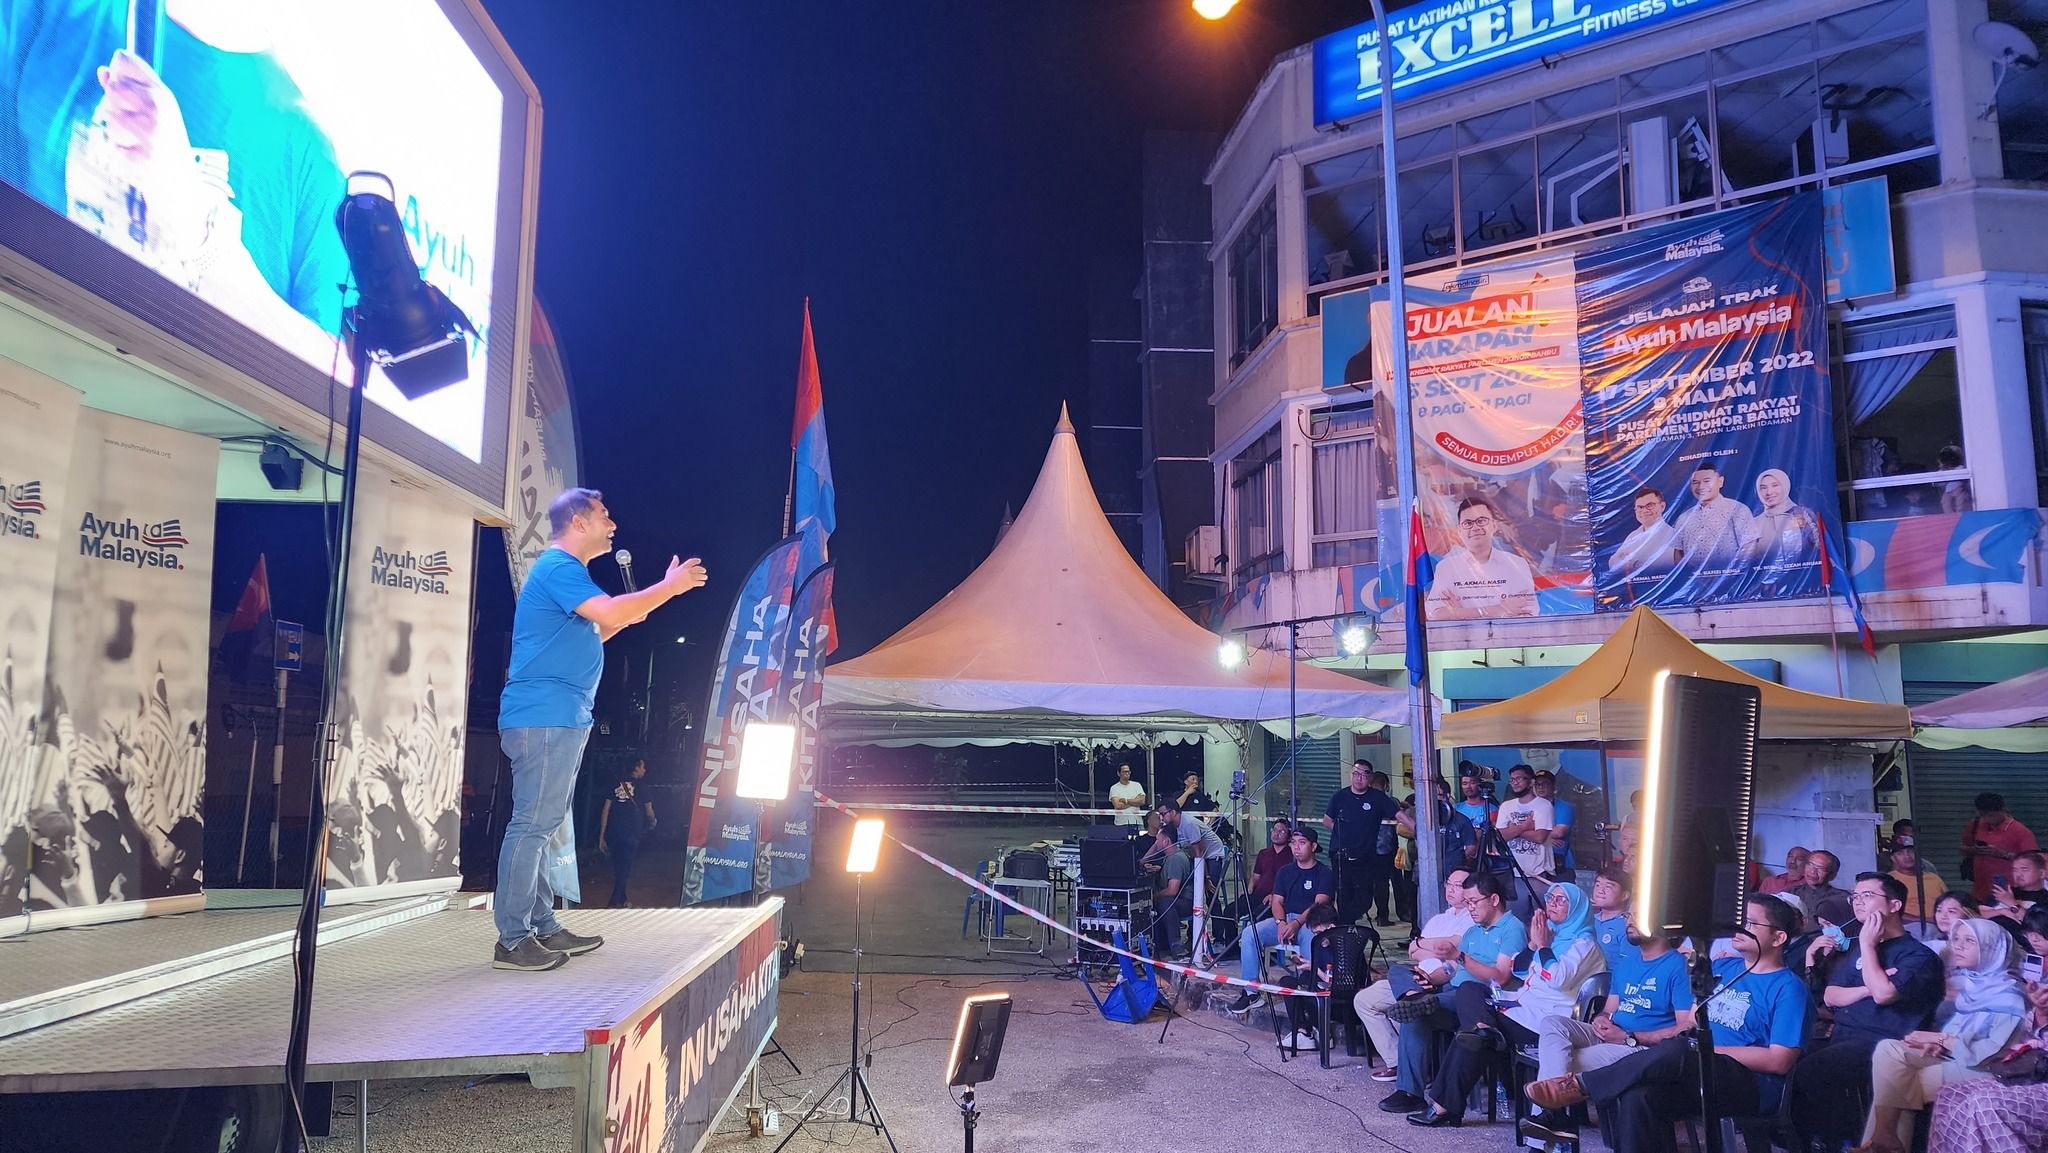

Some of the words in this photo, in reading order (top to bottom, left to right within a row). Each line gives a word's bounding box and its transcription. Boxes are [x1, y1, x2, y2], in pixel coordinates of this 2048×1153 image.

[1408, 0, 1475, 32] LATIHAN
[1582, 0, 1668, 37] FITNESS
[402, 195, 474, 287] Ayuh
[1665, 243, 1724, 261] Malaysia.
[1408, 295, 1528, 337] JUALAN
[1621, 299, 1715, 326] JELAJAH
[1721, 284, 1778, 306] TRAK
[1680, 303, 1792, 342] Malaysia
[1425, 372, 1486, 398] SEPT
[1623, 361, 1755, 397] SEPTEMBER
[1759, 350, 1815, 374] 2022
[1431, 401, 1466, 416] PAGI
[1495, 393, 1532, 409] PAGI
[1673, 380, 1757, 408] MALAM
[1616, 422, 1691, 442] PARLIMEN
[1693, 416, 1743, 431] JOHOR
[1747, 405, 1801, 423] BAHRU
[1618, 416, 1662, 433] PUSAT
[1667, 404, 1732, 425] KHIDMAT
[1738, 395, 1798, 413] RAKYAT
[1696, 428, 1723, 438] TAMAN
[1726, 423, 1756, 433] LARKIN
[1758, 417, 1793, 427] IDAMAN
[1442, 438, 1479, 461] SEMUA
[1481, 446, 1539, 465] DIJEMPUT
[1541, 416, 1579, 449] HADIR!
[0, 512, 40, 540] ysia.
[80, 511, 139, 541] Ayuh
[80, 534, 185, 570] Malaysia.
[371, 545, 416, 570] Ayuh
[371, 565, 450, 595] Malaysia.
[722, 594, 772, 770] USAHA
[799, 698, 821, 793] KITA
[698, 744, 727, 808] INI
[679, 1021, 706, 1105] INI
[706, 970, 757, 1066] USAHA
[758, 946, 779, 1005] KITA
